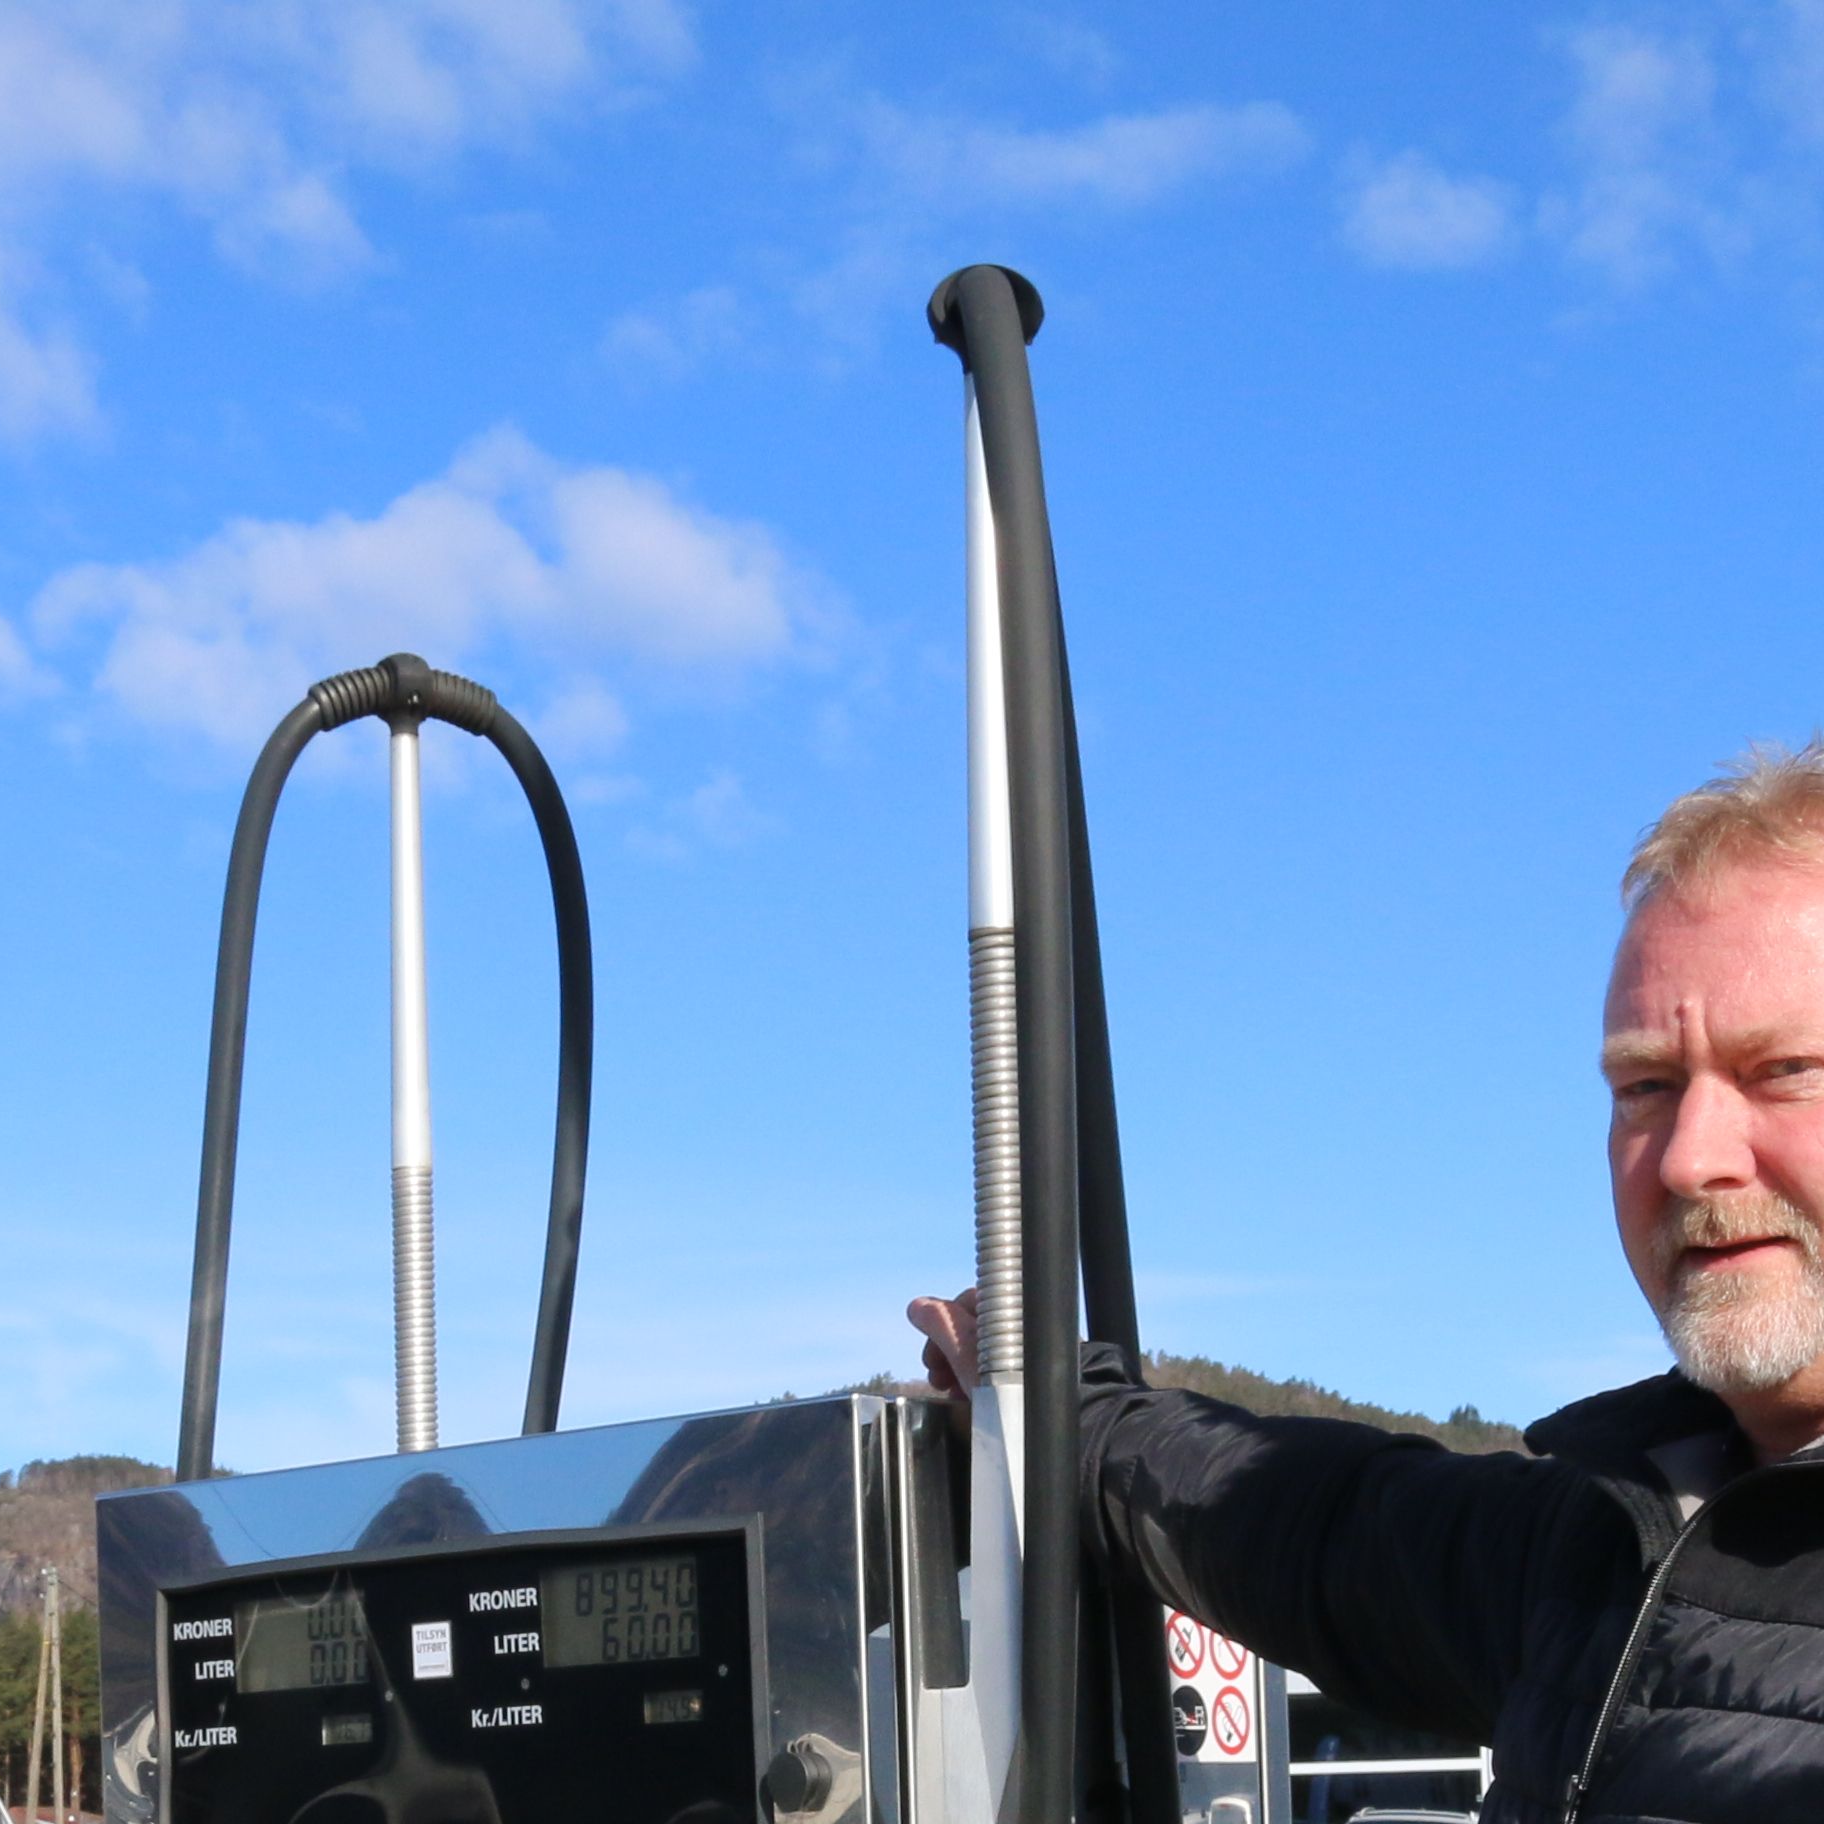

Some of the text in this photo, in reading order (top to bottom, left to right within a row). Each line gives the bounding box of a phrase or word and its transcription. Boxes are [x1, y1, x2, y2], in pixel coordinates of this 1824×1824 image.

[469, 1587, 538, 1612] KRONER
[173, 1618, 233, 1641] KRONER
[494, 1632, 540, 1655] LITER
[195, 1659, 235, 1680] LITER
[471, 1705, 543, 1729] Kr./LITER
[175, 1727, 238, 1748] Kr./LITER
